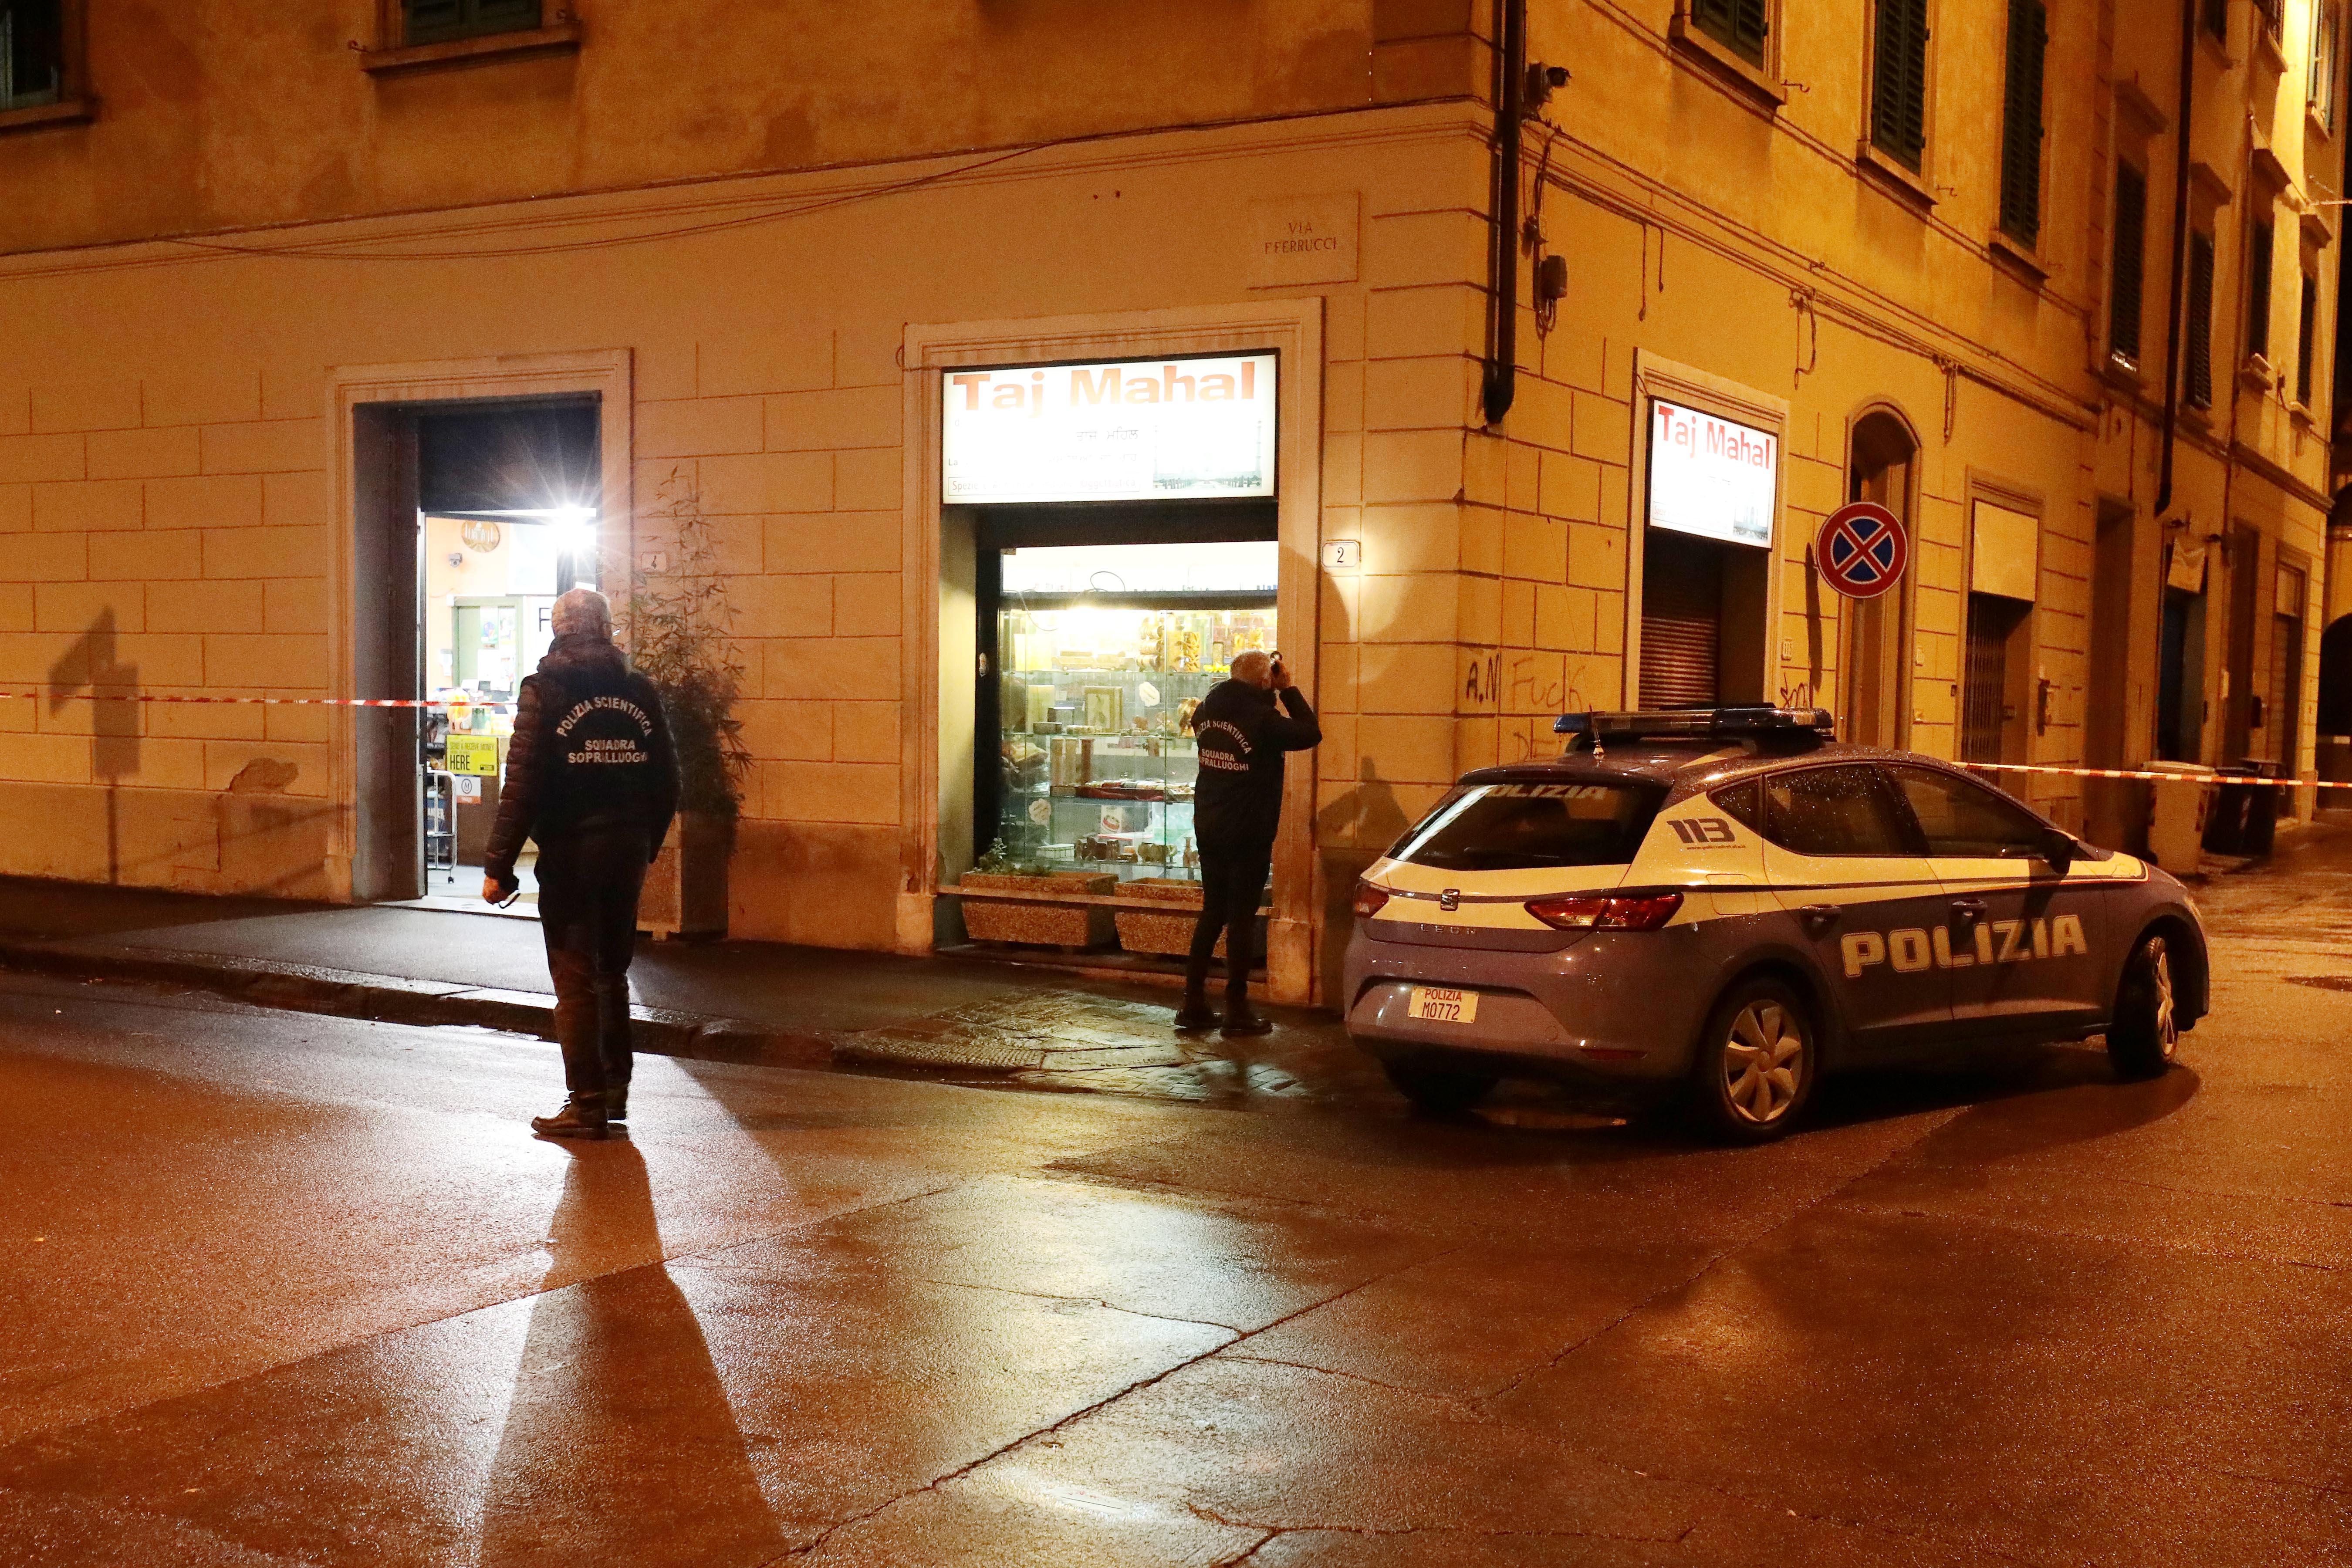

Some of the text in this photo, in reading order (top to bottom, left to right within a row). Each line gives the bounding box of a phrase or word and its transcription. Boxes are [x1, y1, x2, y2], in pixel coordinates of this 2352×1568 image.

[1289, 222, 1312, 234] VIA
[953, 362, 1255, 418] Taj Mahal
[1659, 405, 1770, 469] Taj Mahal
[1337, 547, 1344, 563] 2
[556, 696, 652, 737] POLIZIA SCIENTIFICA
[585, 740, 635, 750] SQUADRA
[1213, 720, 1252, 754] SCIENTIFICA
[450, 754, 470, 770] HERE
[1199, 756, 1249, 770] PRALLUOGHI
[1202, 748, 1235, 762] SQUADRA
[1479, 784, 1608, 800] OLIZIA
[1666, 818, 1735, 843] 113
[1841, 914, 2088, 978] POLIZIA
[1425, 988, 1462, 1002] POLIZIA
[1422, 1002, 1460, 1020] M0772
